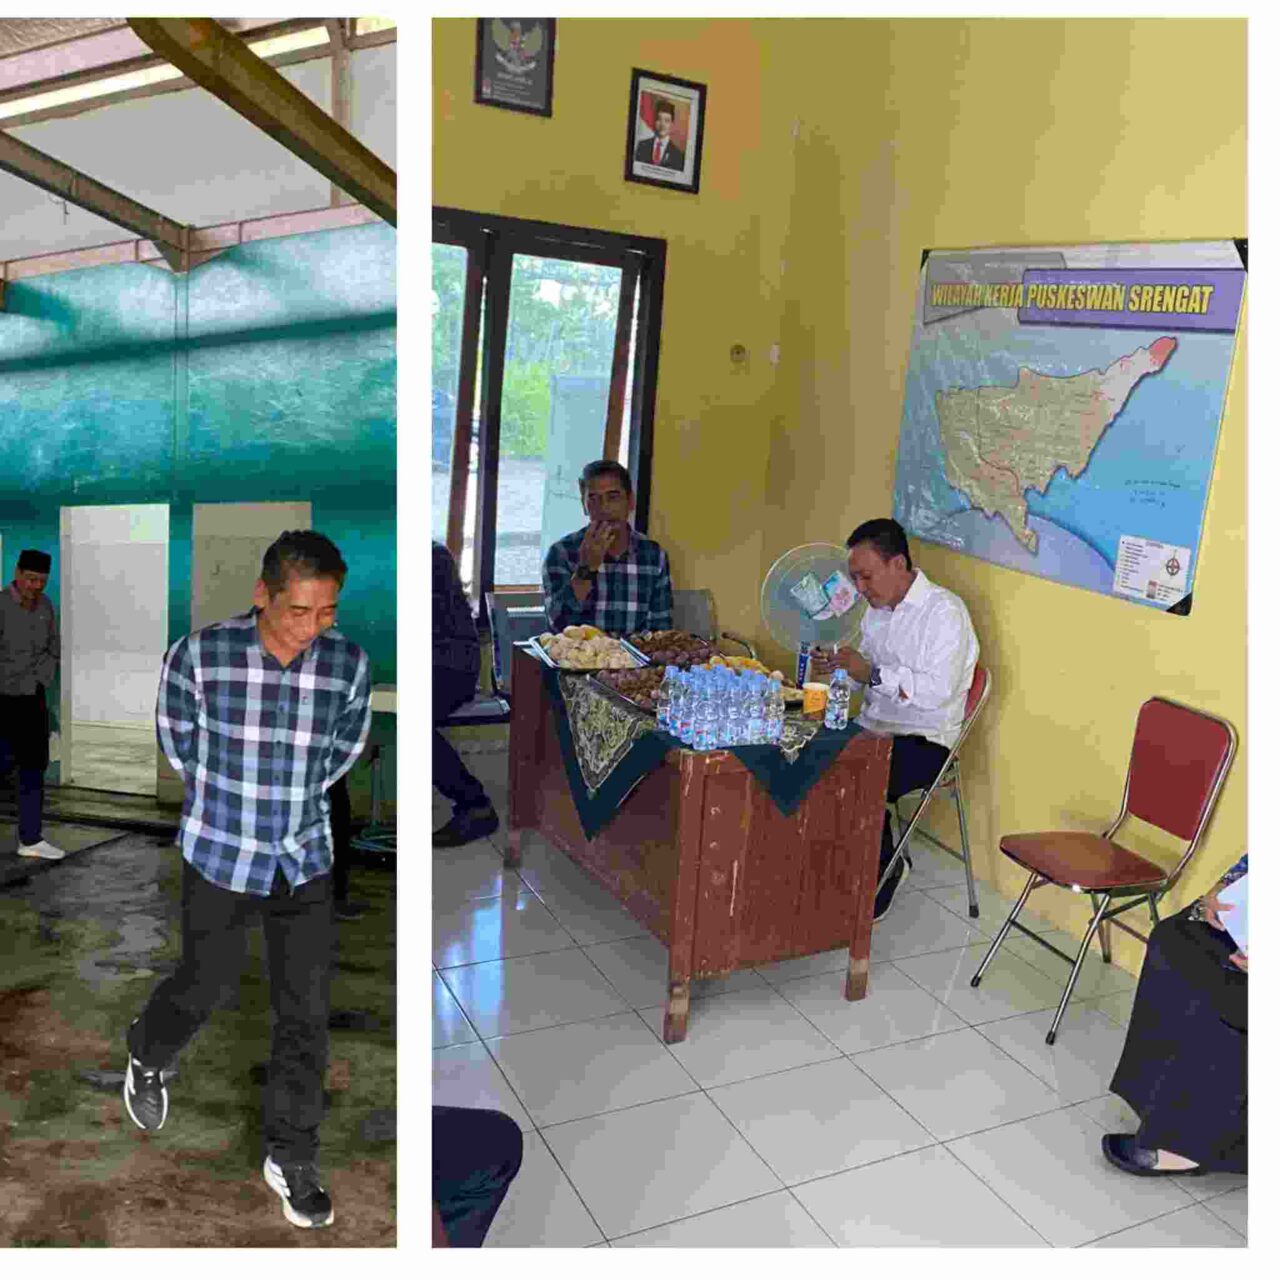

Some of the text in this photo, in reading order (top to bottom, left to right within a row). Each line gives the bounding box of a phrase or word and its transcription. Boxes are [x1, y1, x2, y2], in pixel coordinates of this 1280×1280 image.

[983, 282, 1025, 309] KERJA
[1026, 283, 1125, 311] PUSKESWAN
[1128, 284, 1214, 315] SRENGAT
